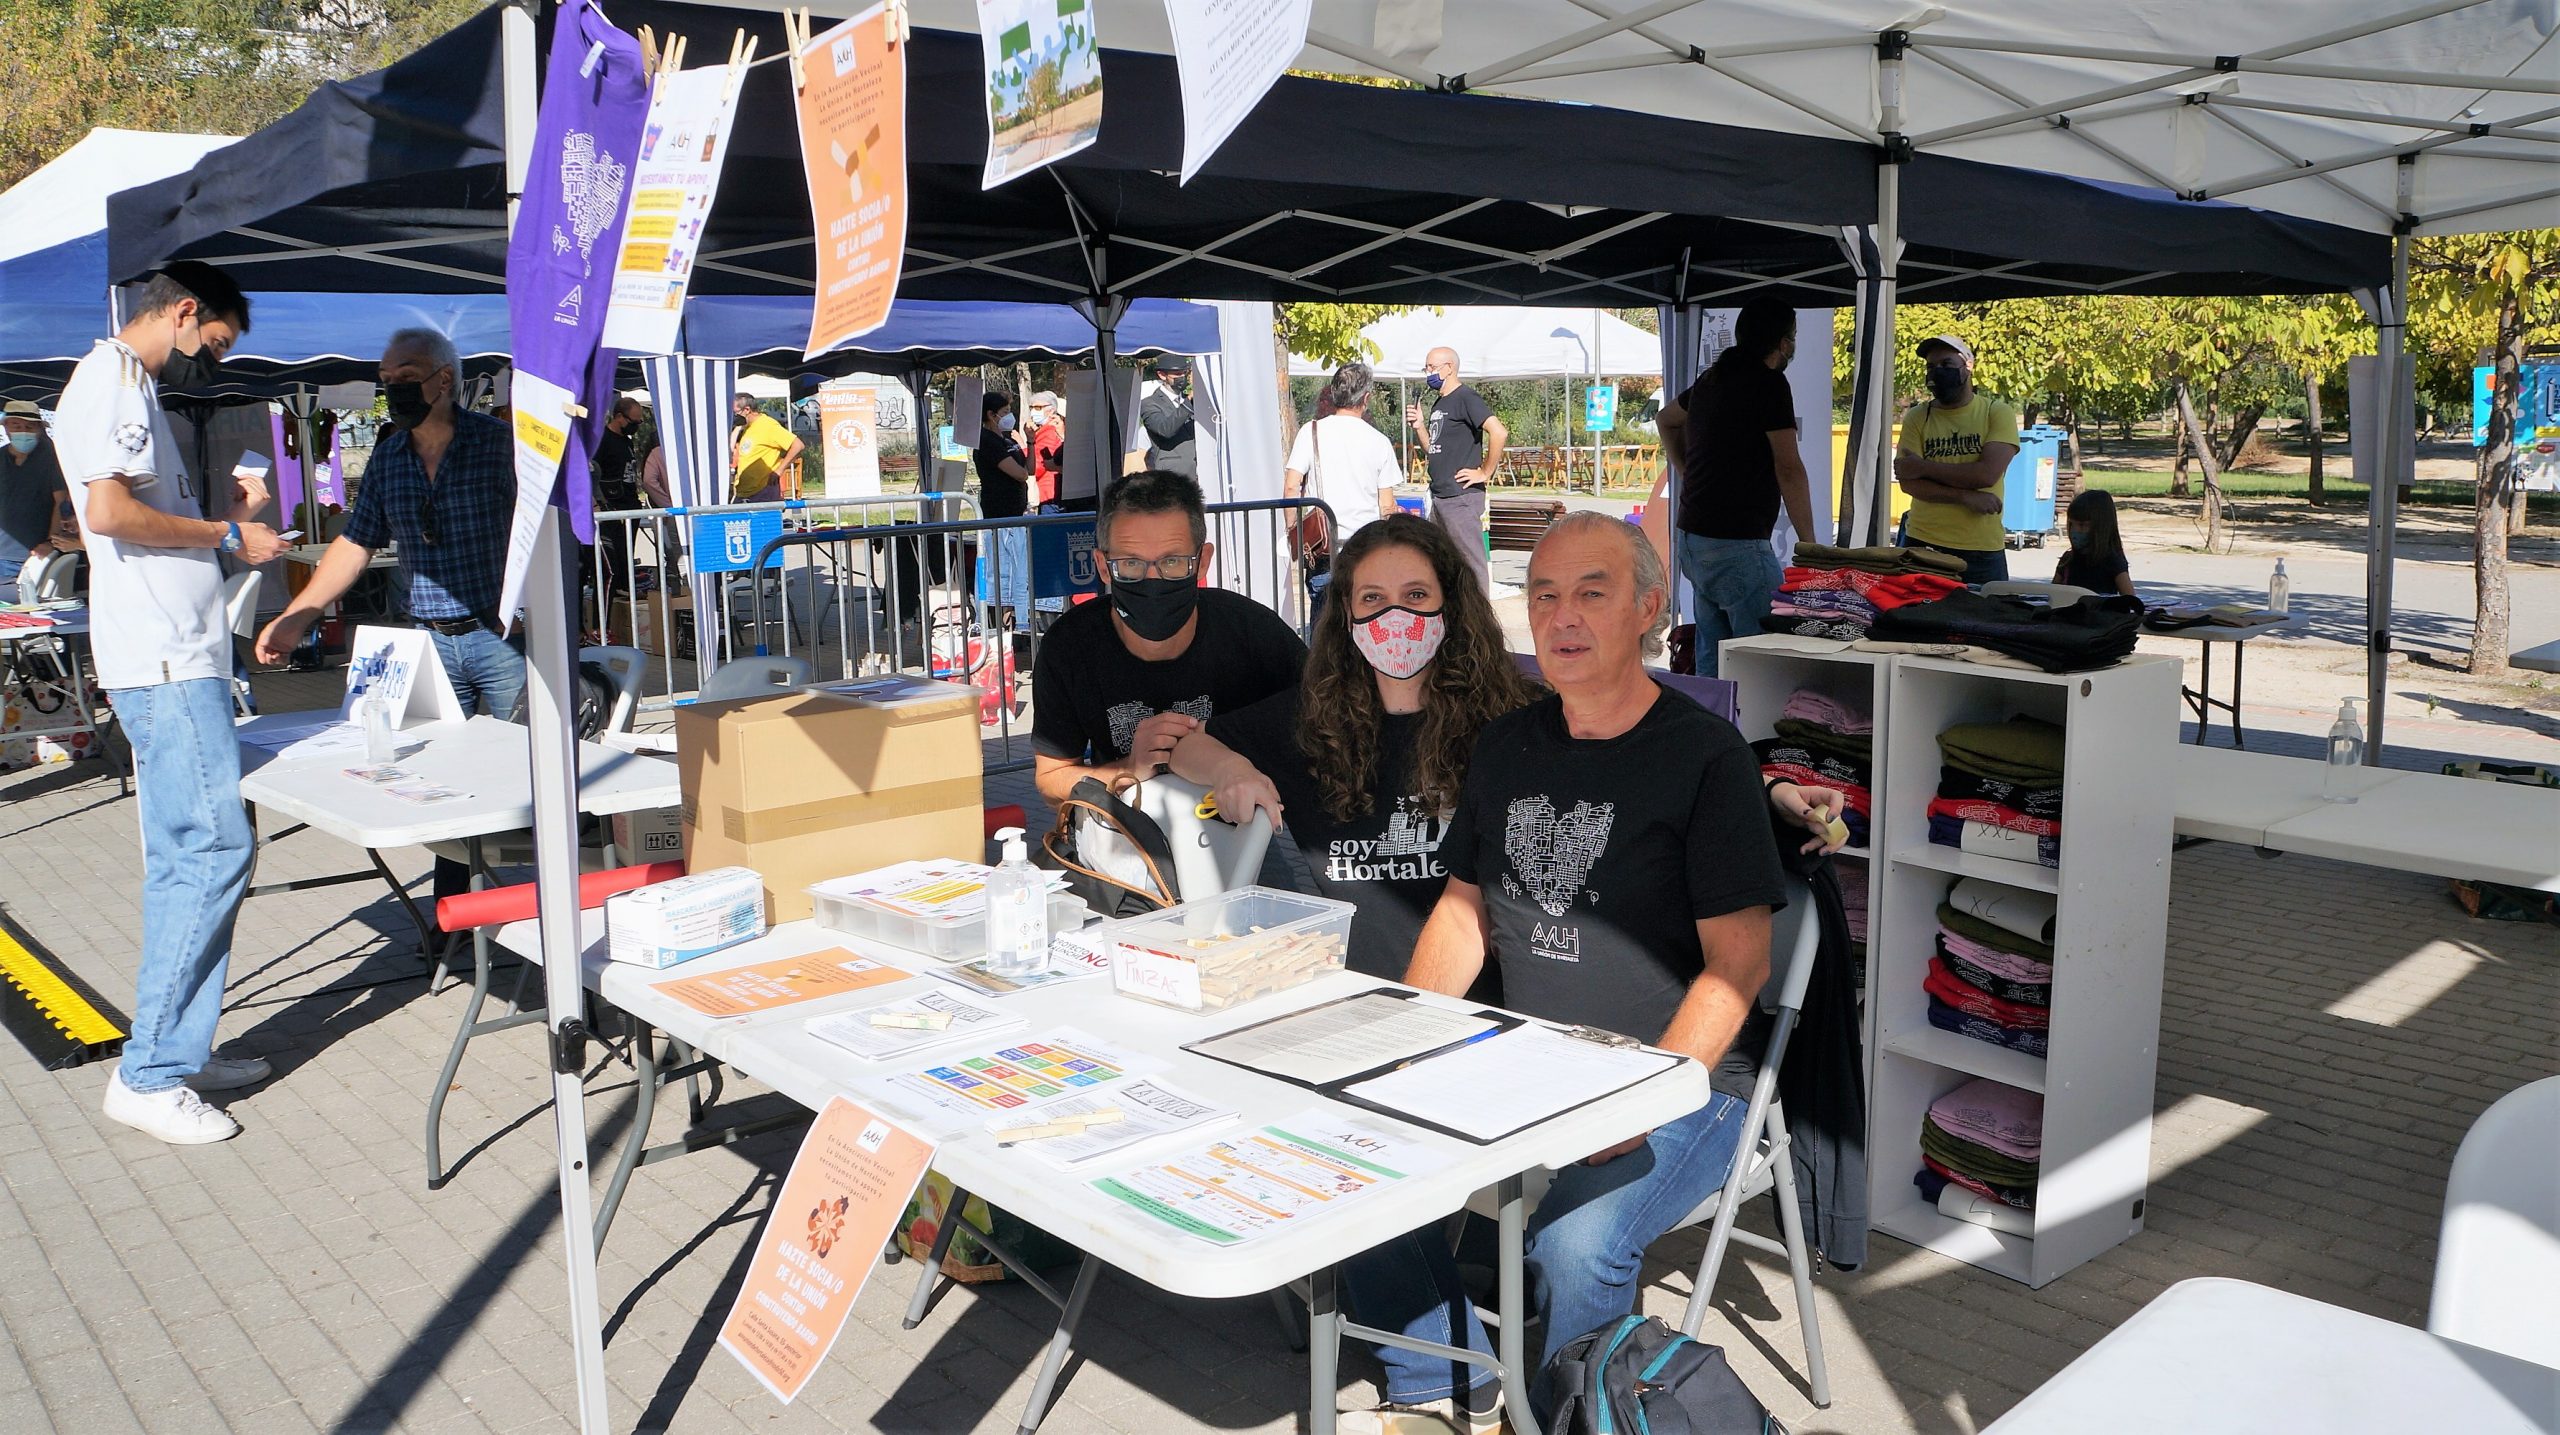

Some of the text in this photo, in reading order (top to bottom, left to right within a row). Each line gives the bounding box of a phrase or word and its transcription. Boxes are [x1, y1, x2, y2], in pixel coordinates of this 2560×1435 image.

[830, 193, 890, 239] HAZTE SOCIA/O
[837, 221, 884, 260] DE LA UNIÓN
[1329, 840, 1378, 862] soy
[1977, 823, 2016, 841] XXL
[1329, 853, 1449, 881] Hortale
[661, 950, 677, 962] 50
[1055, 937, 1089, 956] PROYECTO
[1080, 951, 1109, 967] NO
[1120, 950, 1180, 997] PINZAS
[819, 1156, 852, 1180] necesitamos
[852, 1176, 859, 1184] tu
[860, 1180, 877, 1195] apoyo
[826, 1147, 886, 1187] La Unión de Hortaleza
[828, 1134, 895, 1178] En la Asociación Vecinal
[825, 1173, 868, 1203] tu participación
[775, 1263, 829, 1310] DE LA UNIÓN
[778, 1239, 844, 1295] HAZTE SOCIA/O
